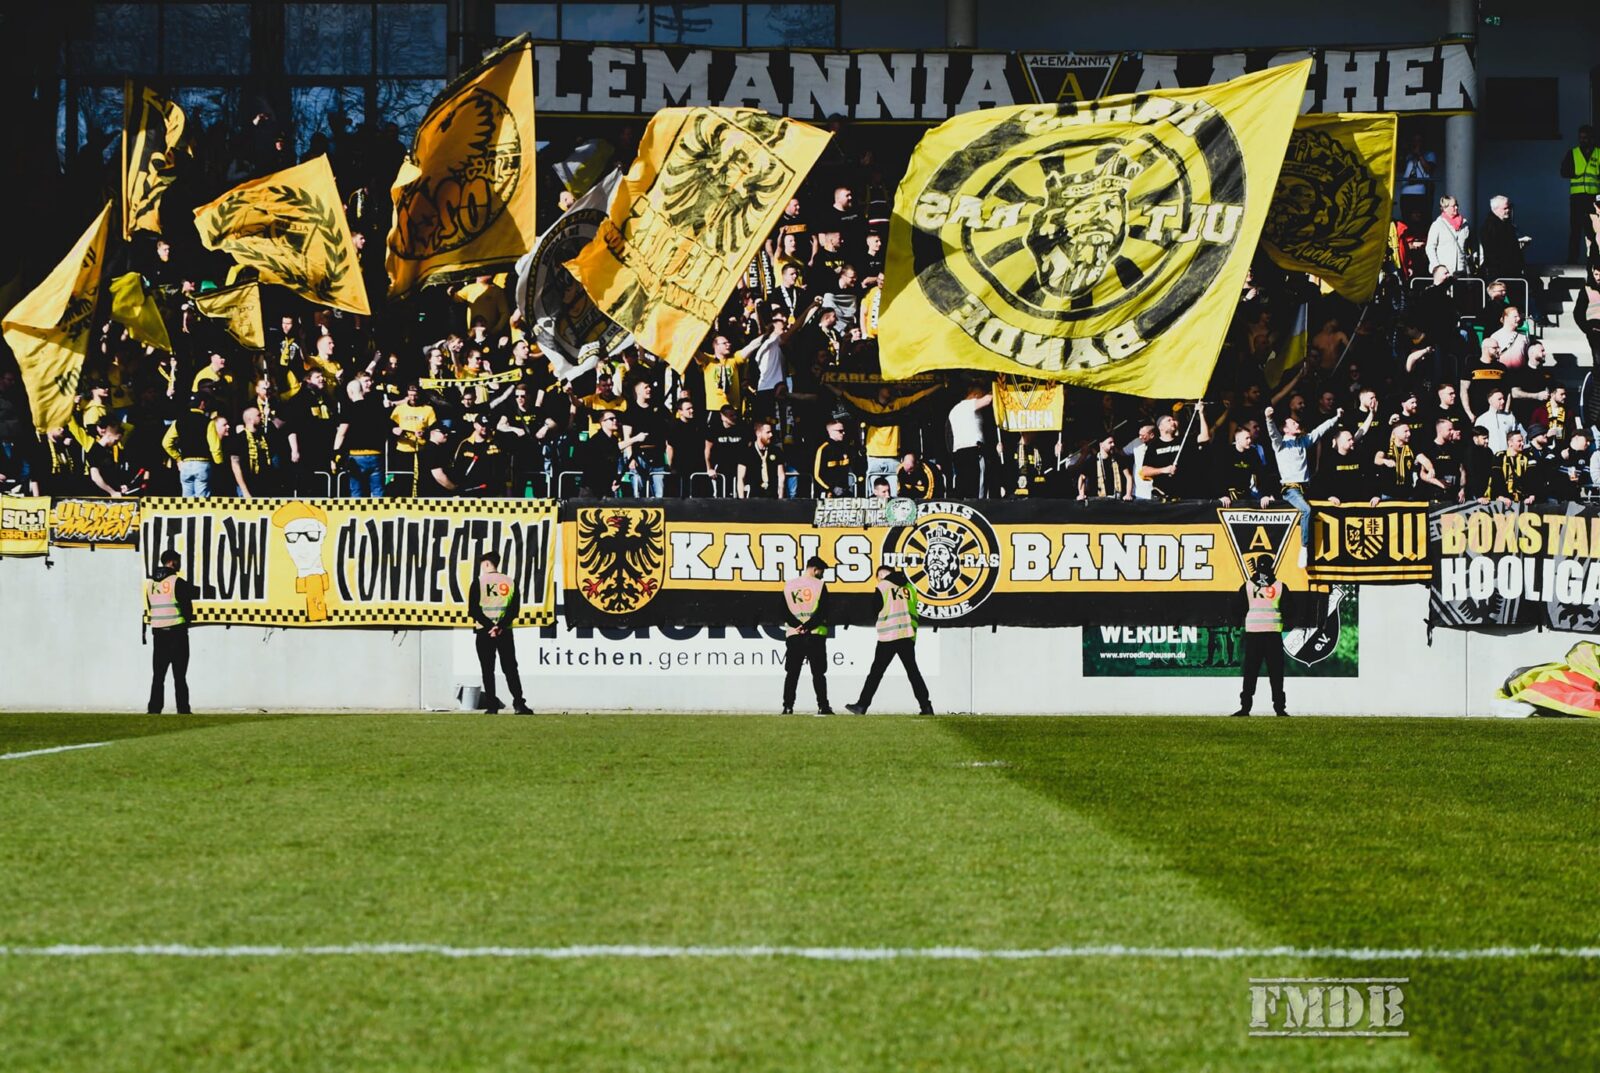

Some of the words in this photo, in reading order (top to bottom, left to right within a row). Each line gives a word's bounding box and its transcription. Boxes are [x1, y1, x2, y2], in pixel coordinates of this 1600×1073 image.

[1029, 56, 1112, 67] ALEMANNIA
[534, 46, 1016, 119] LEMANNIA
[1056, 73, 1085, 101] A
[57, 501, 135, 521] ULTRAS
[1228, 514, 1292, 523] ALEMANNIA
[1249, 525, 1273, 551] A
[669, 531, 873, 583] KARLS
[1010, 532, 1214, 582] BANDE
[883, 553, 922, 568] ULT
[962, 553, 1000, 568] RAS
[151, 581, 171, 595] K9
[486, 583, 510, 598] K9
[891, 587, 911, 601] K9
[791, 589, 813, 604] K9
[916, 600, 973, 618] BANDE
[1100, 651, 1187, 660] www.svroedinghausen.de
